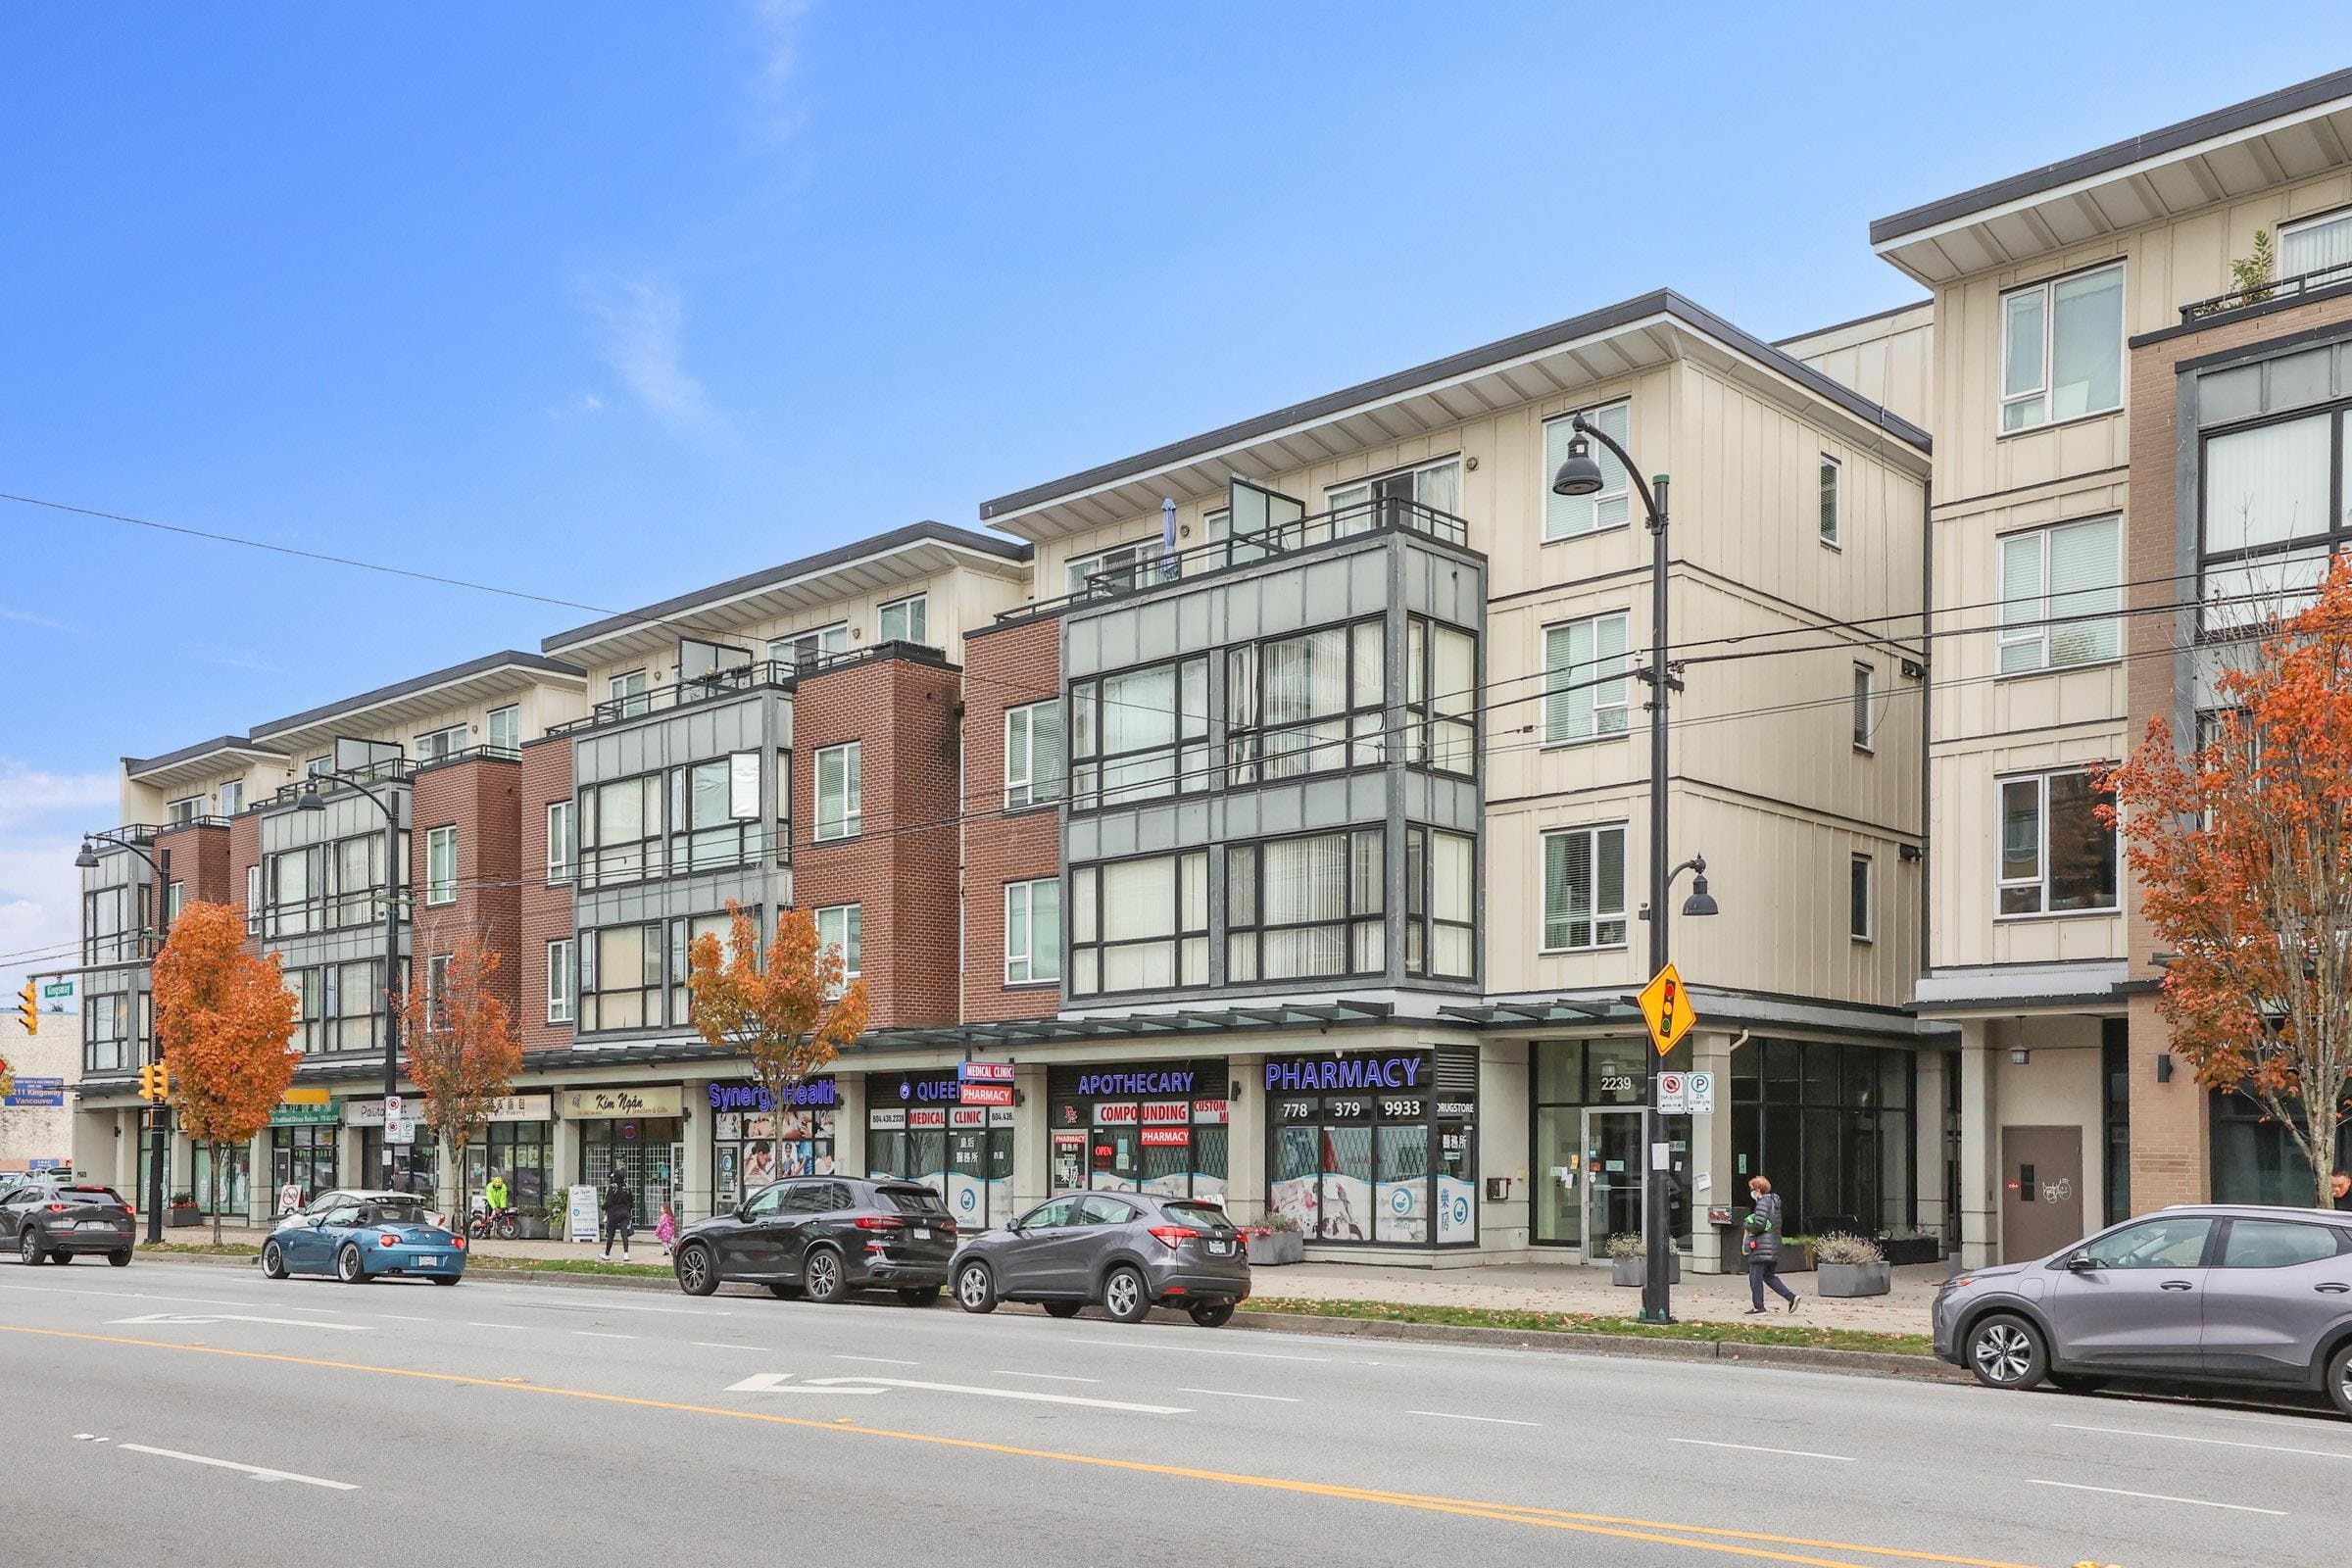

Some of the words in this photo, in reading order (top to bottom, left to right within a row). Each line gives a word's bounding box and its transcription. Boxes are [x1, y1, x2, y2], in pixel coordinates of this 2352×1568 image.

[966, 1064, 992, 1077] MEDICAL
[994, 1065, 1012, 1078] CLINIC
[1265, 1057, 1420, 1090] PHARMACY
[1078, 1072, 1194, 1095] APOTHECARY
[1601, 1076, 1632, 1091] 2239
[1696, 1078, 1705, 1089] P
[596, 1093, 615, 1110] Kim
[962, 1089, 1010, 1102] PHARMACY
[1193, 1100, 1227, 1112] CUSTOM
[1283, 1102, 1308, 1118] 778
[1334, 1102, 1361, 1117] 379
[1385, 1101, 1421, 1116] 9933
[909, 1111, 945, 1125] MEDICAL
[954, 1110, 982, 1124] CLINIC
[1055, 1135, 1084, 1144] PHARMACY
[1142, 1131, 1189, 1142] PHARMACY
[1095, 1146, 1112, 1156] OPEN
